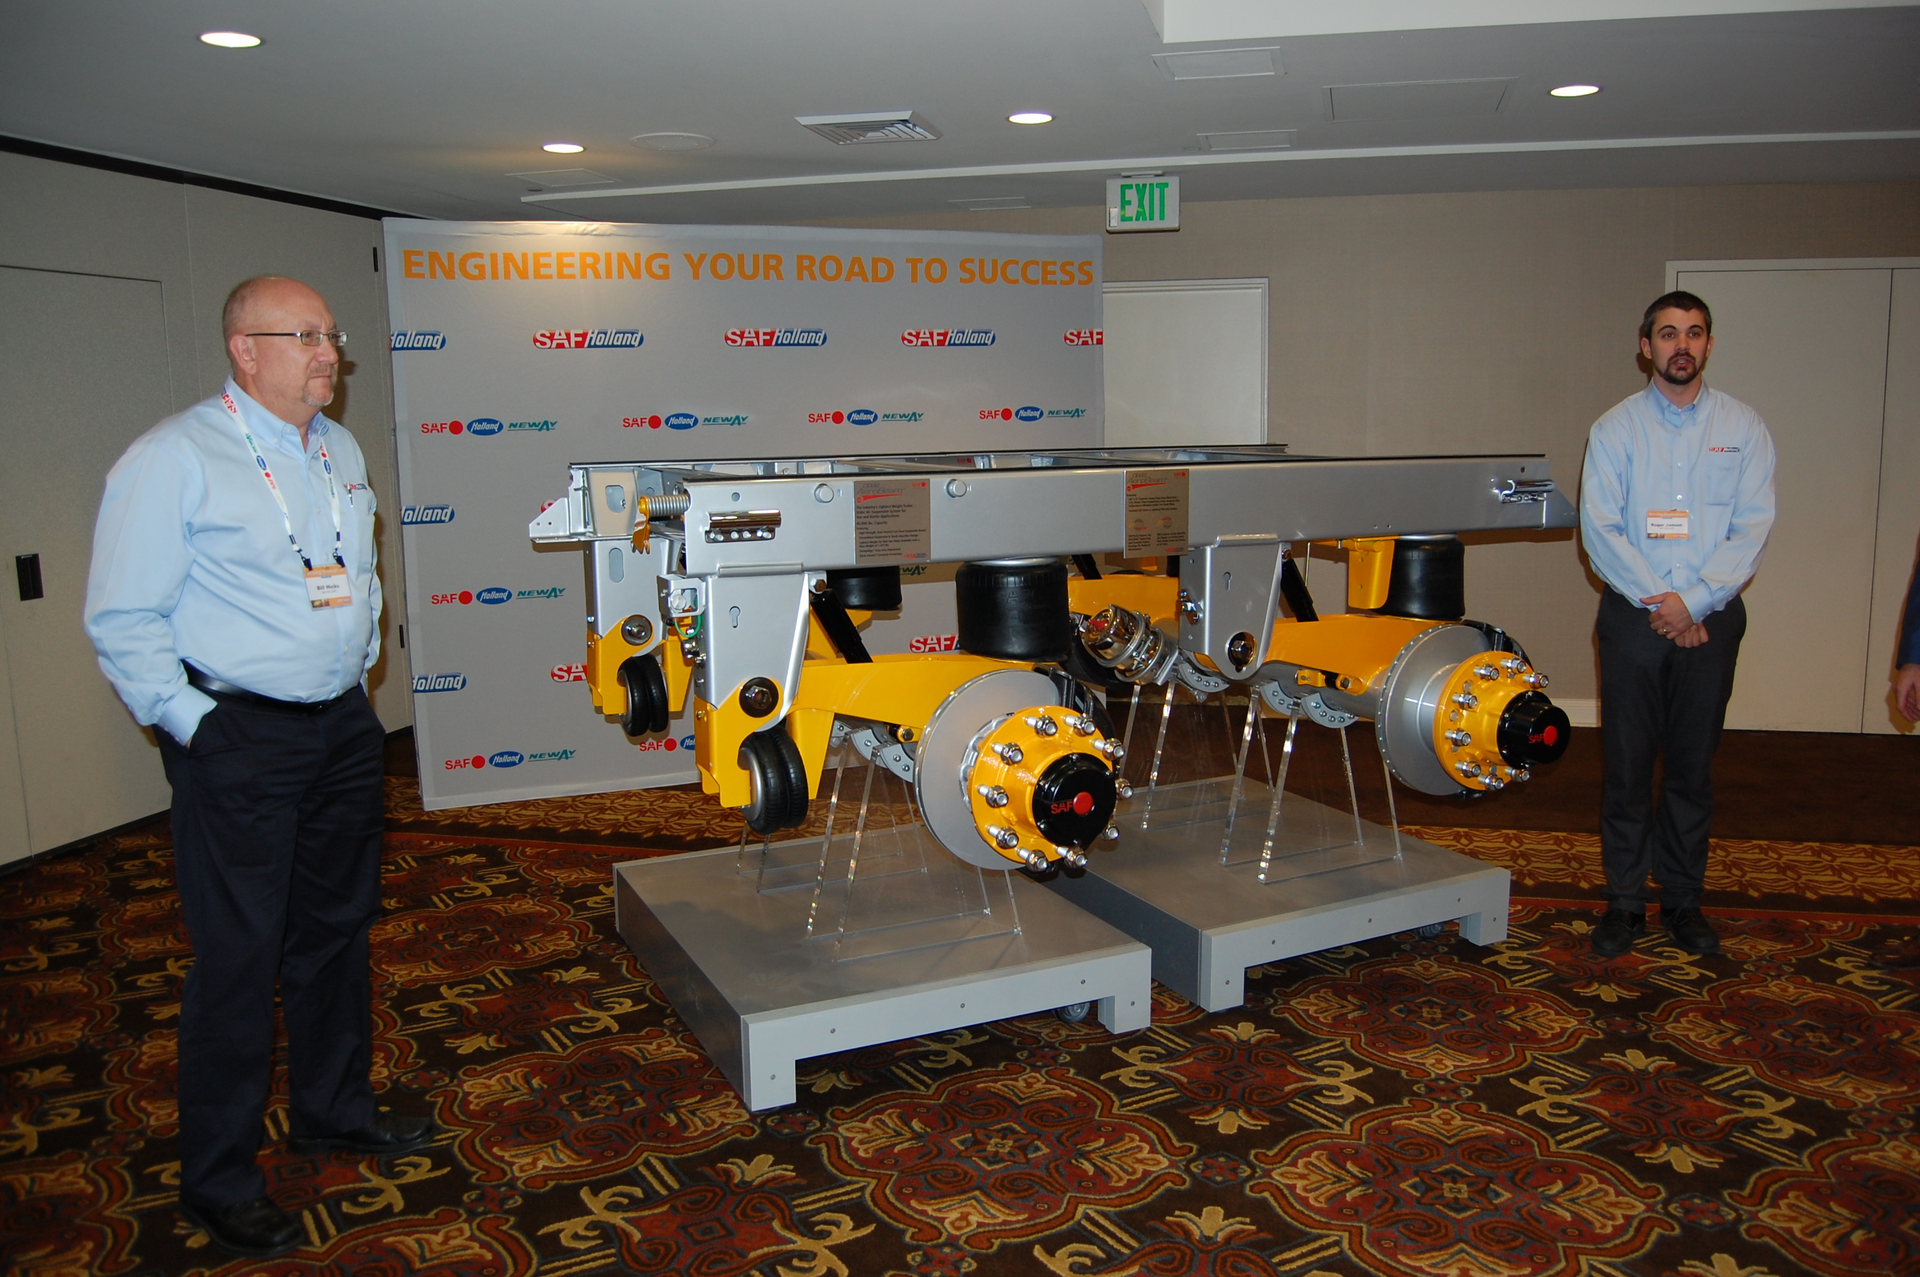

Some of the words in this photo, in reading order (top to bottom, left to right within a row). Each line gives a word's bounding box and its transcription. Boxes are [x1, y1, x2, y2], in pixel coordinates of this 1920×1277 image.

[1120, 182, 1170, 222] EXIT
[403, 249, 671, 281] ENGINEERING
[683, 252, 785, 281] YOUR
[796, 254, 895, 283] ROAD
[905, 257, 948, 284] TO
[959, 258, 1094, 286] SUCCESS
[535, 329, 583, 349] SAF
[584, 329, 642, 348] Holland
[726, 328, 772, 347] SAF
[772, 328, 826, 347] Holland
[902, 328, 945, 347] SAF
[945, 328, 994, 347] Holland
[1065, 328, 1103, 346] SAF
[622, 416, 648, 429] SAF
[667, 414, 696, 428] Holland
[703, 414, 749, 427] NEWAY
[808, 412, 831, 424] SAF
[849, 410, 876, 423] Holland
[882, 411, 924, 422] NEWAY
[979, 409, 1001, 420] SAF
[1017, 407, 1042, 420] Holland
[1047, 407, 1086, 419] NEWAY
[421, 422, 448, 435] SAF
[469, 420, 501, 434] Holland
[508, 419, 558, 432] NEWAY
[901, 565, 927, 576] WAY
[431, 592, 458, 605] SAF
[480, 588, 510, 603] Holland
[517, 586, 566, 599] NEWAY
[911, 634, 952, 653] SAF
[552, 662, 588, 682] SA
[639, 740, 664, 752] SAF
[444, 757, 471, 771] SAF
[492, 752, 521, 766] Holland
[529, 748, 577, 761] NEWAY
[1051, 800, 1073, 815] SAF
